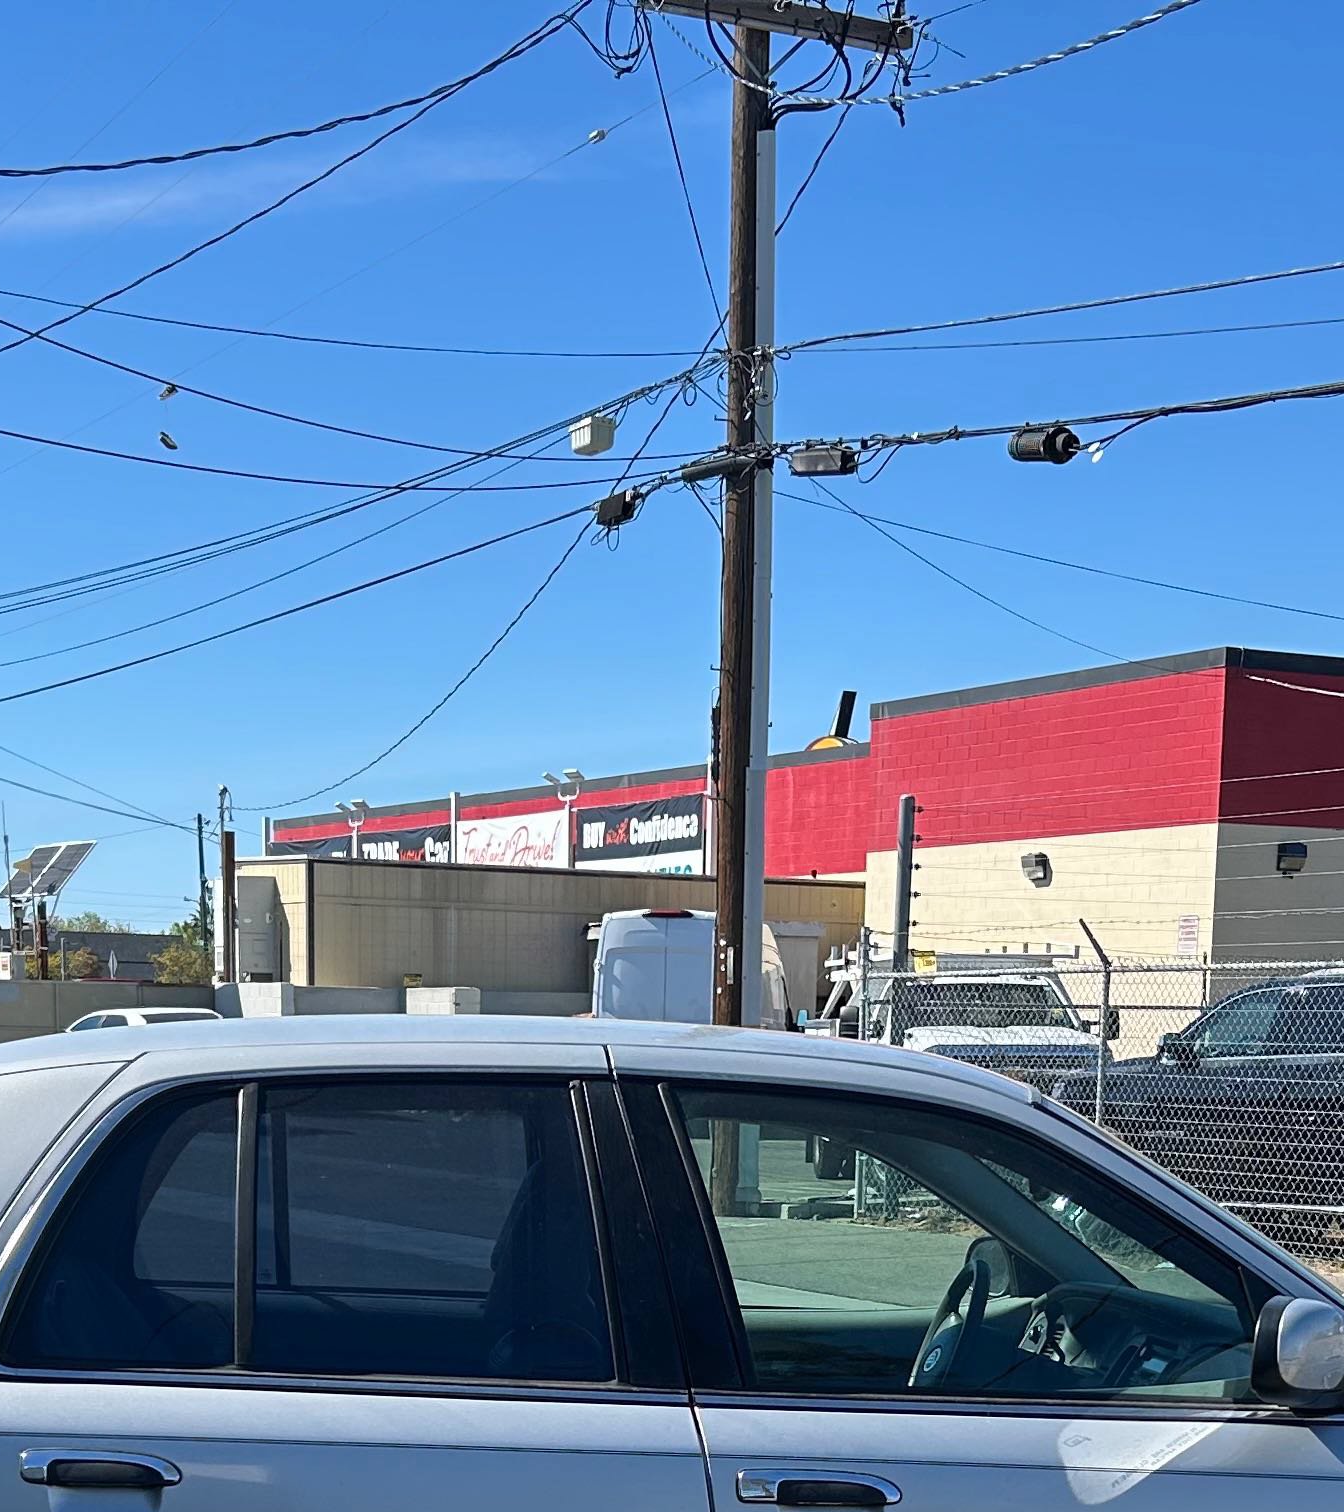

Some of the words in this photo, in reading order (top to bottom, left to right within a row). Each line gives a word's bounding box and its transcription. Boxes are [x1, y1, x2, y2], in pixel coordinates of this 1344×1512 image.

[582, 821, 605, 849] BUY
[629, 813, 699, 845] Confidence
[361, 841, 399, 861] TRADE
[424, 836, 450, 863] Car
